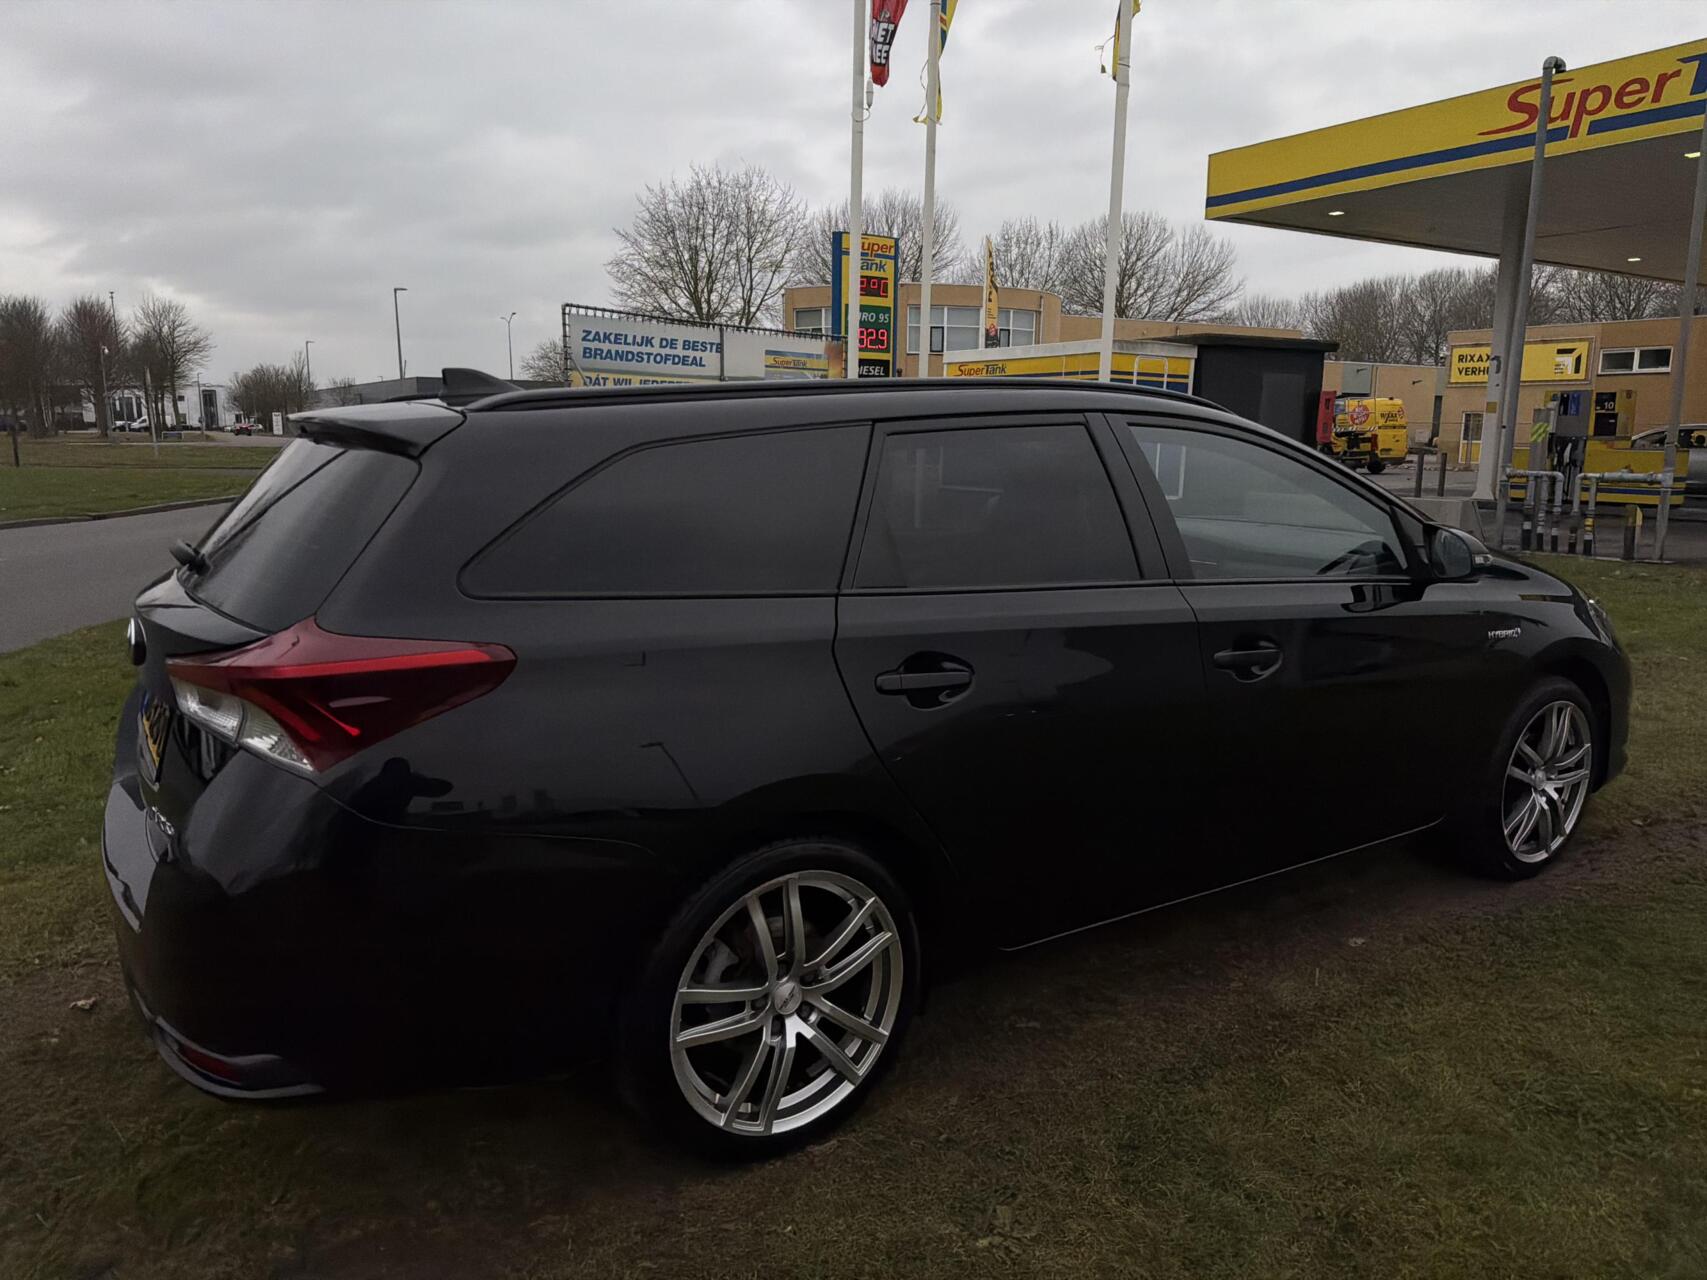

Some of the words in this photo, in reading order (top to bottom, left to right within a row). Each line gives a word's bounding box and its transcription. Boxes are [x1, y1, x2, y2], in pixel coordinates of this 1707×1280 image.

[852, 237, 895, 258] uper
[878, 313, 890, 323] 95
[581, 329, 655, 348] ZAKELIJK
[659, 337, 678, 350] DE
[682, 340, 721, 353] BESTE
[582, 346, 706, 367] BRANDSTOFDEAL
[859, 365, 885, 376] IESEL
[953, 362, 1007, 376] SuperTank
